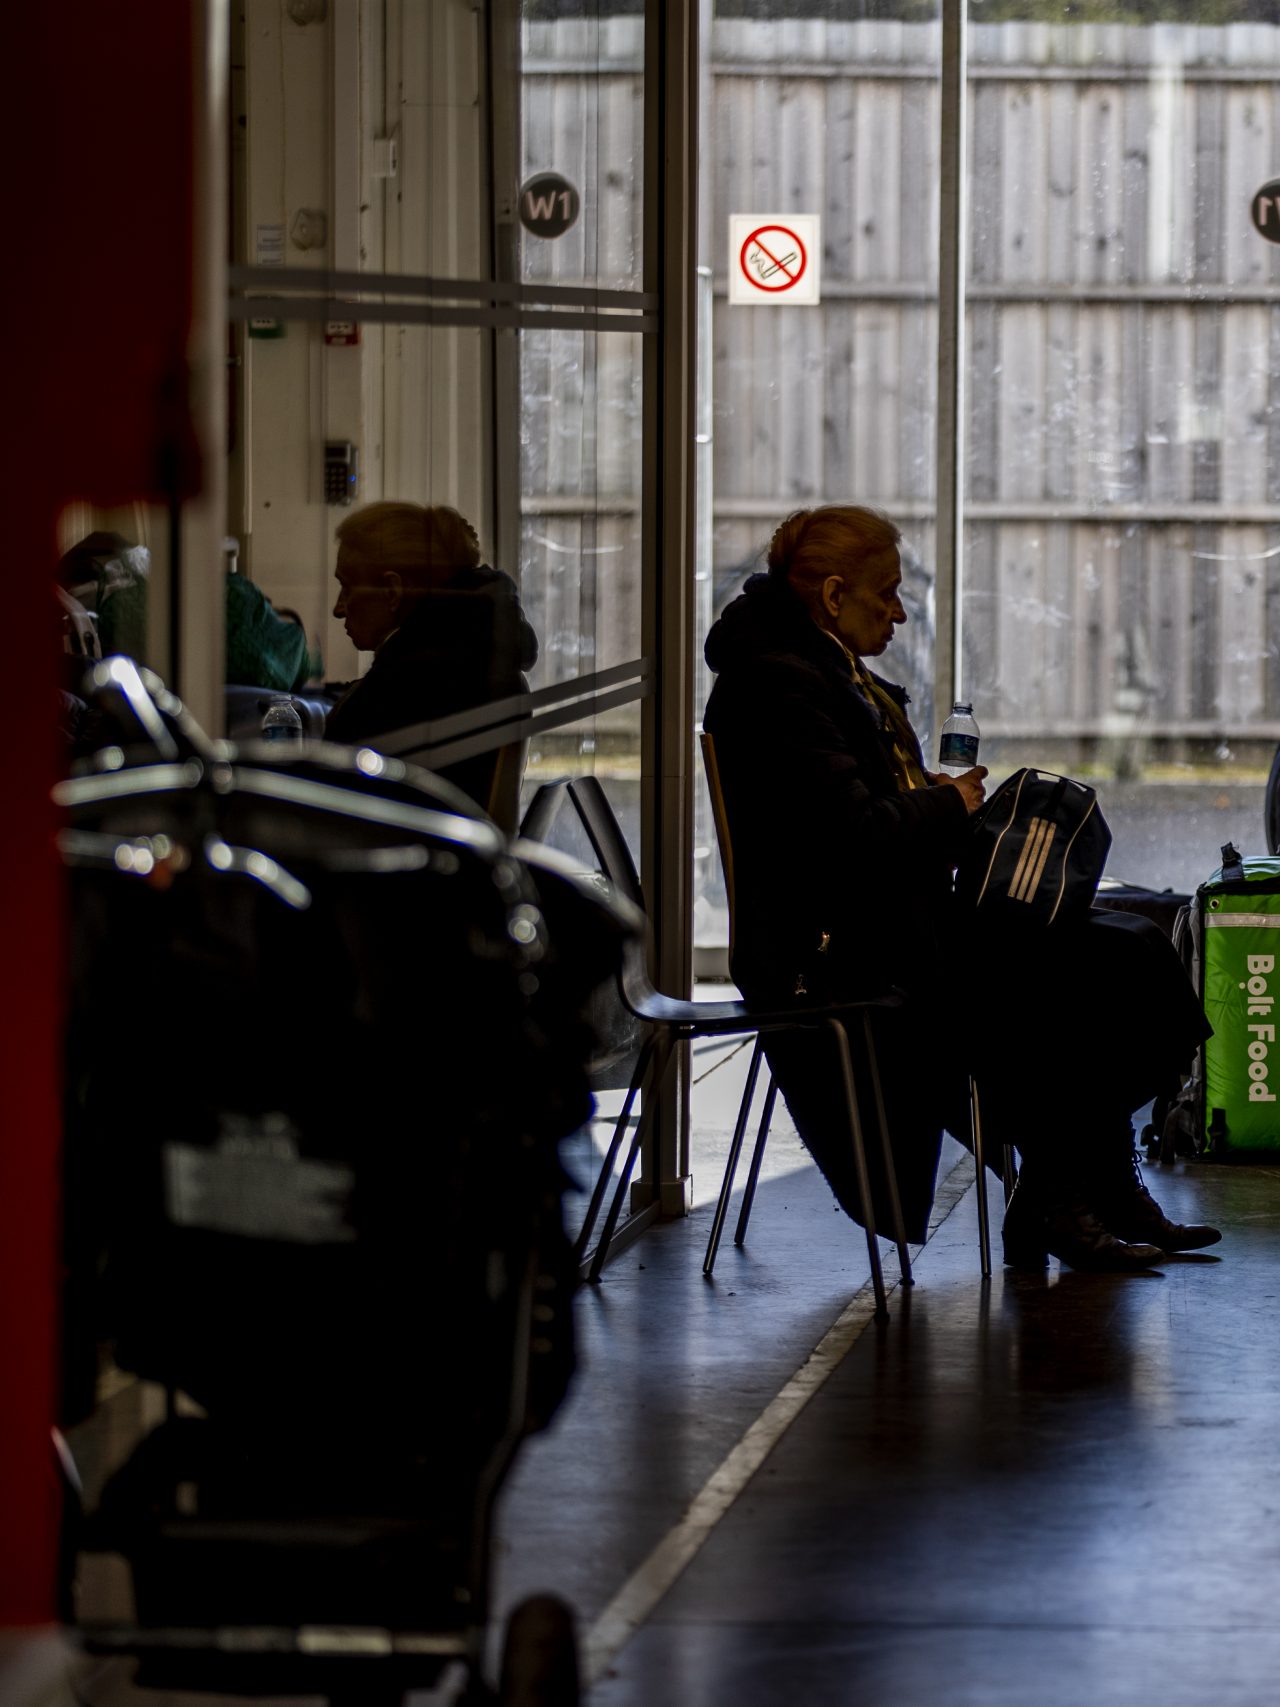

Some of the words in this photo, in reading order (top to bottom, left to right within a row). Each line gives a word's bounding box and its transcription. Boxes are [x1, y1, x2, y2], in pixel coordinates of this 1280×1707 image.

[526, 190, 571, 221] W1
[1241, 955, 1275, 1016] Bolt
[1248, 1024, 1276, 1102] Food
